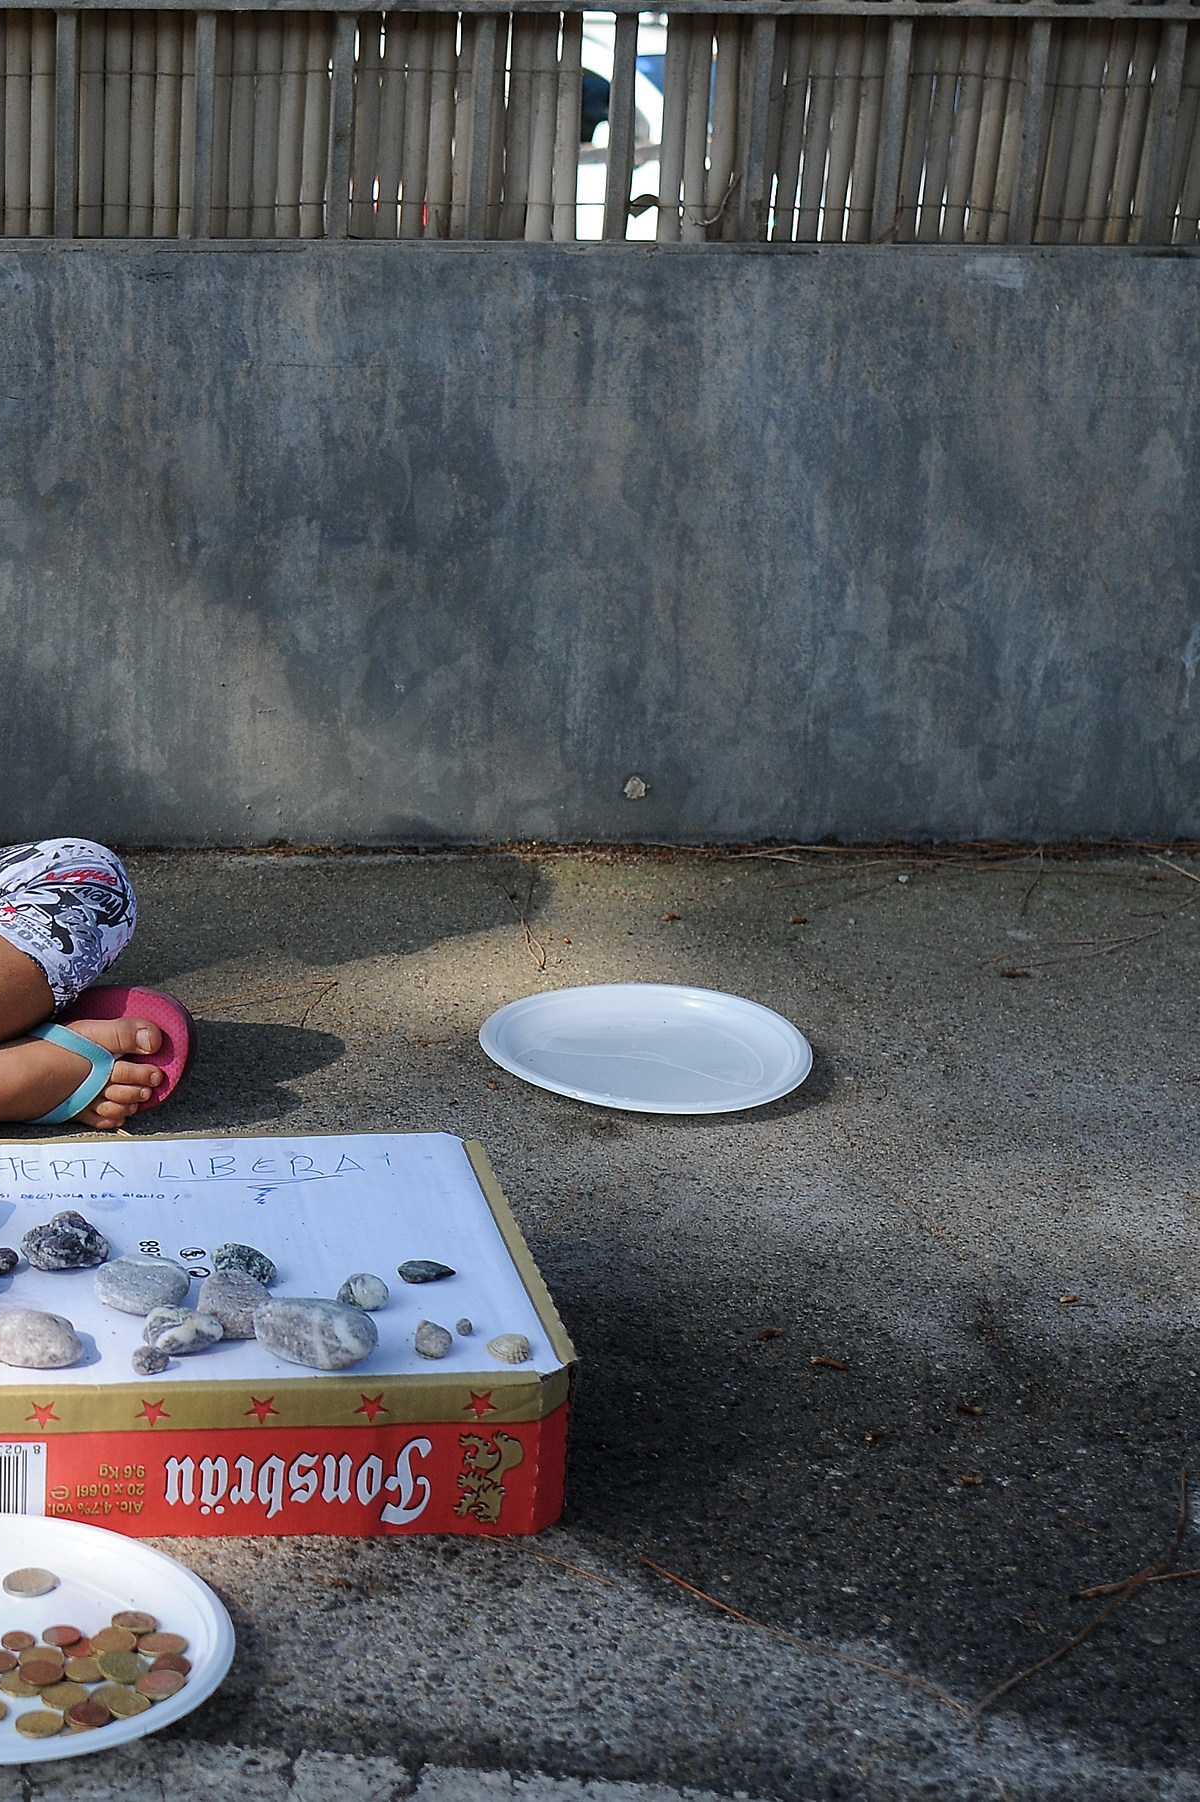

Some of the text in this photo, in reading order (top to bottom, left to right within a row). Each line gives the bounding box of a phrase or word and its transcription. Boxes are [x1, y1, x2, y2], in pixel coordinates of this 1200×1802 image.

[99, 1463, 146, 1479] 9,6 Kg
[127, 1483, 145, 1496] 20
[163, 1437, 433, 1526] Fonsbräu
[48, 1500, 144, 1516] Alc. 4,7% vol.
